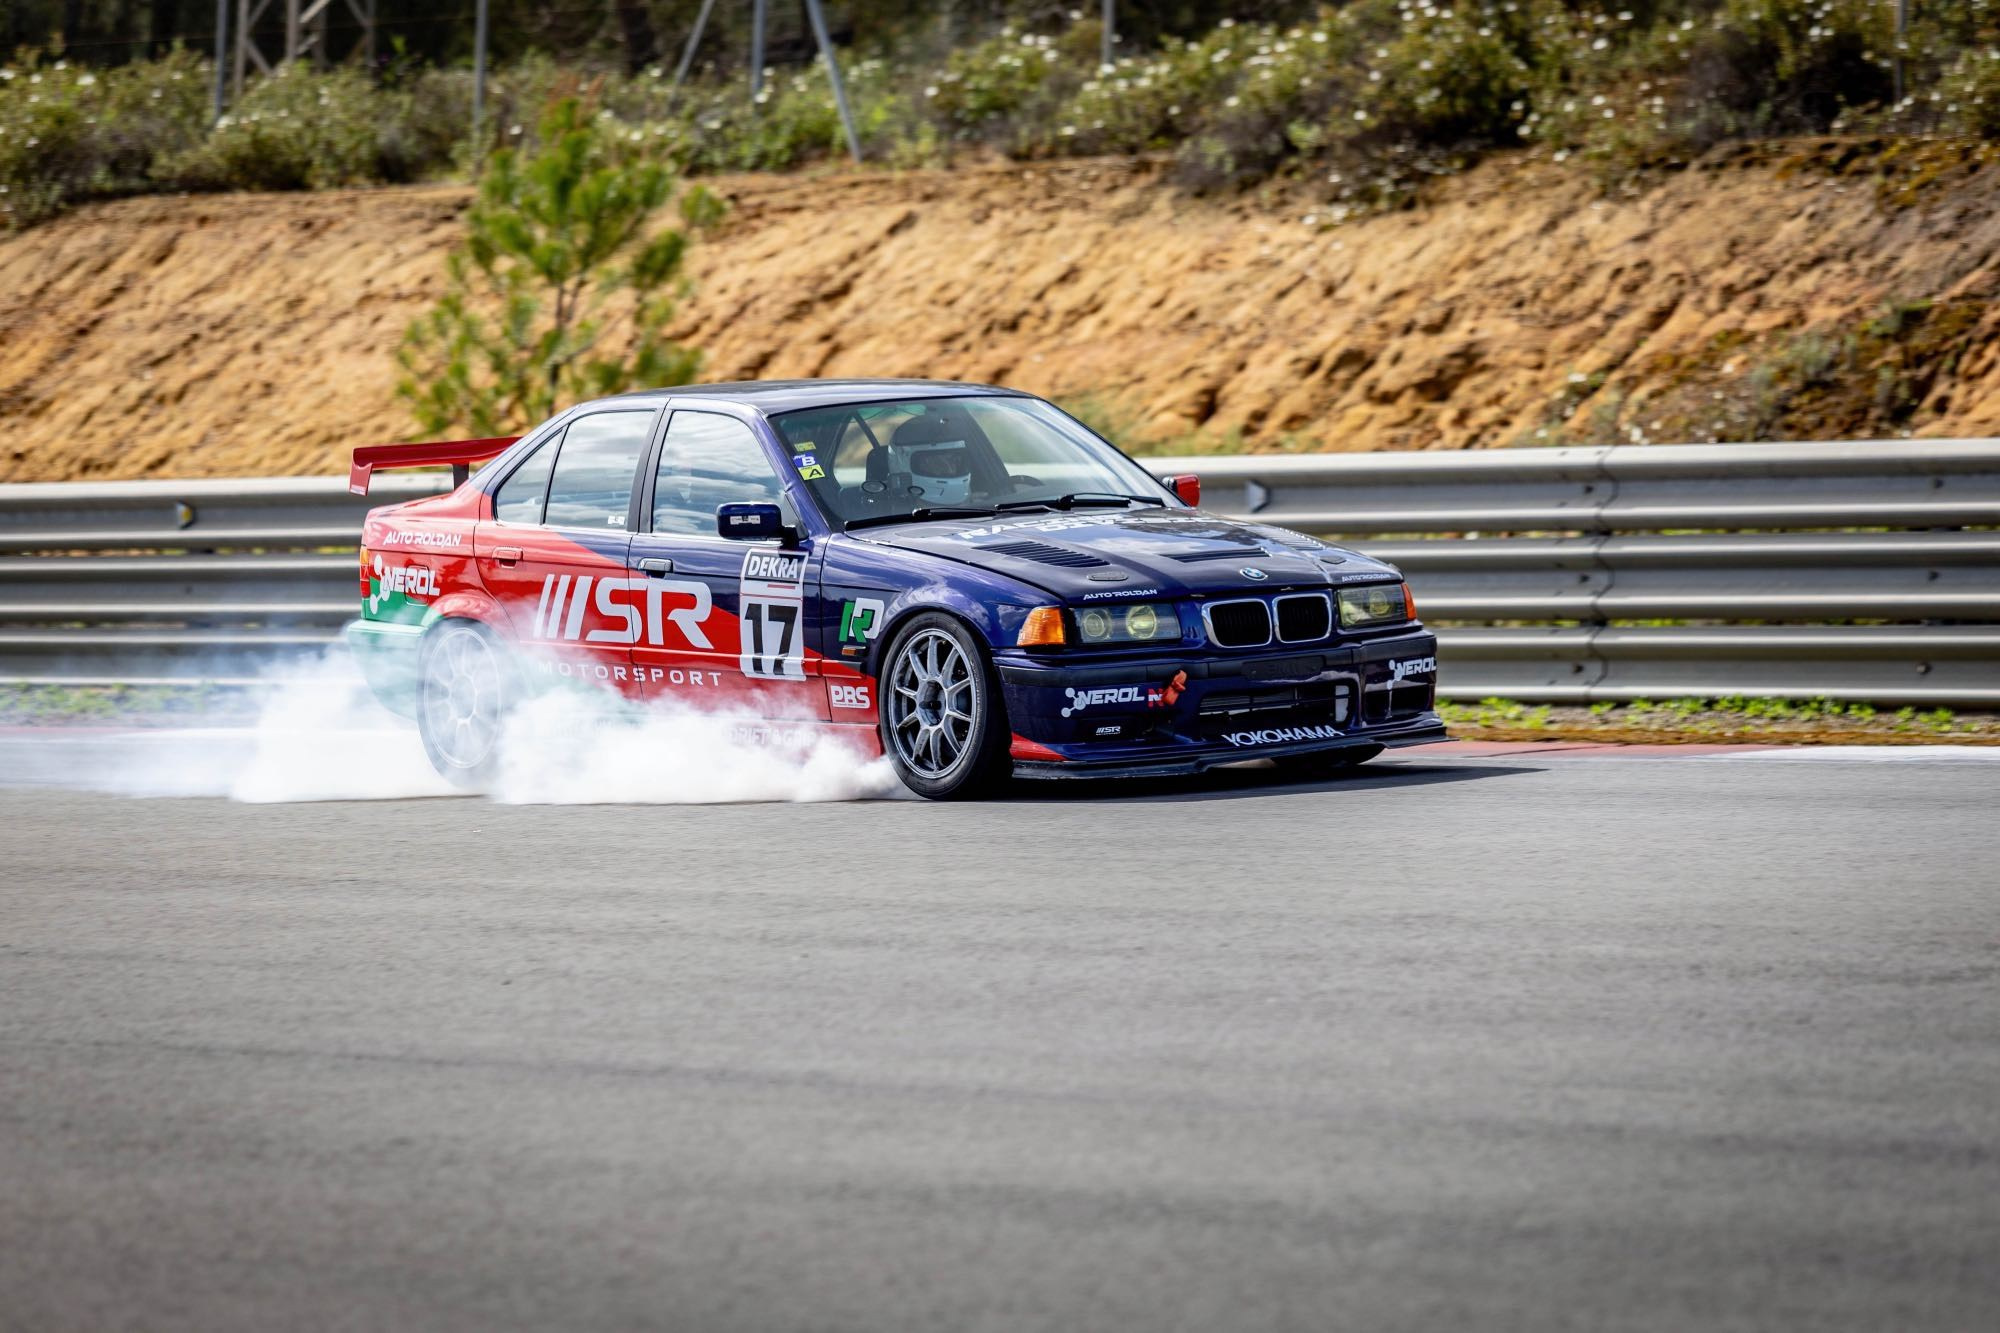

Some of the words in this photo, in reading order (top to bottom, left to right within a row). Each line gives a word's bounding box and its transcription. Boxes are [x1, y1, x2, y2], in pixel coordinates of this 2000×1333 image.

[383, 531, 413, 546] AUTO
[414, 532, 462, 548] ROLDAN
[747, 555, 799, 579] DEKRA
[382, 565, 441, 596] NEROL
[1083, 592, 1112, 600] AUTO
[1112, 589, 1158, 597] ROLDAN
[744, 602, 799, 676] 17
[538, 662, 722, 687] MOTORSPORT
[1395, 656, 1438, 677] NEROL
[1077, 686, 1145, 705] NEROL
[1221, 724, 1345, 747] YOKOHAMA
